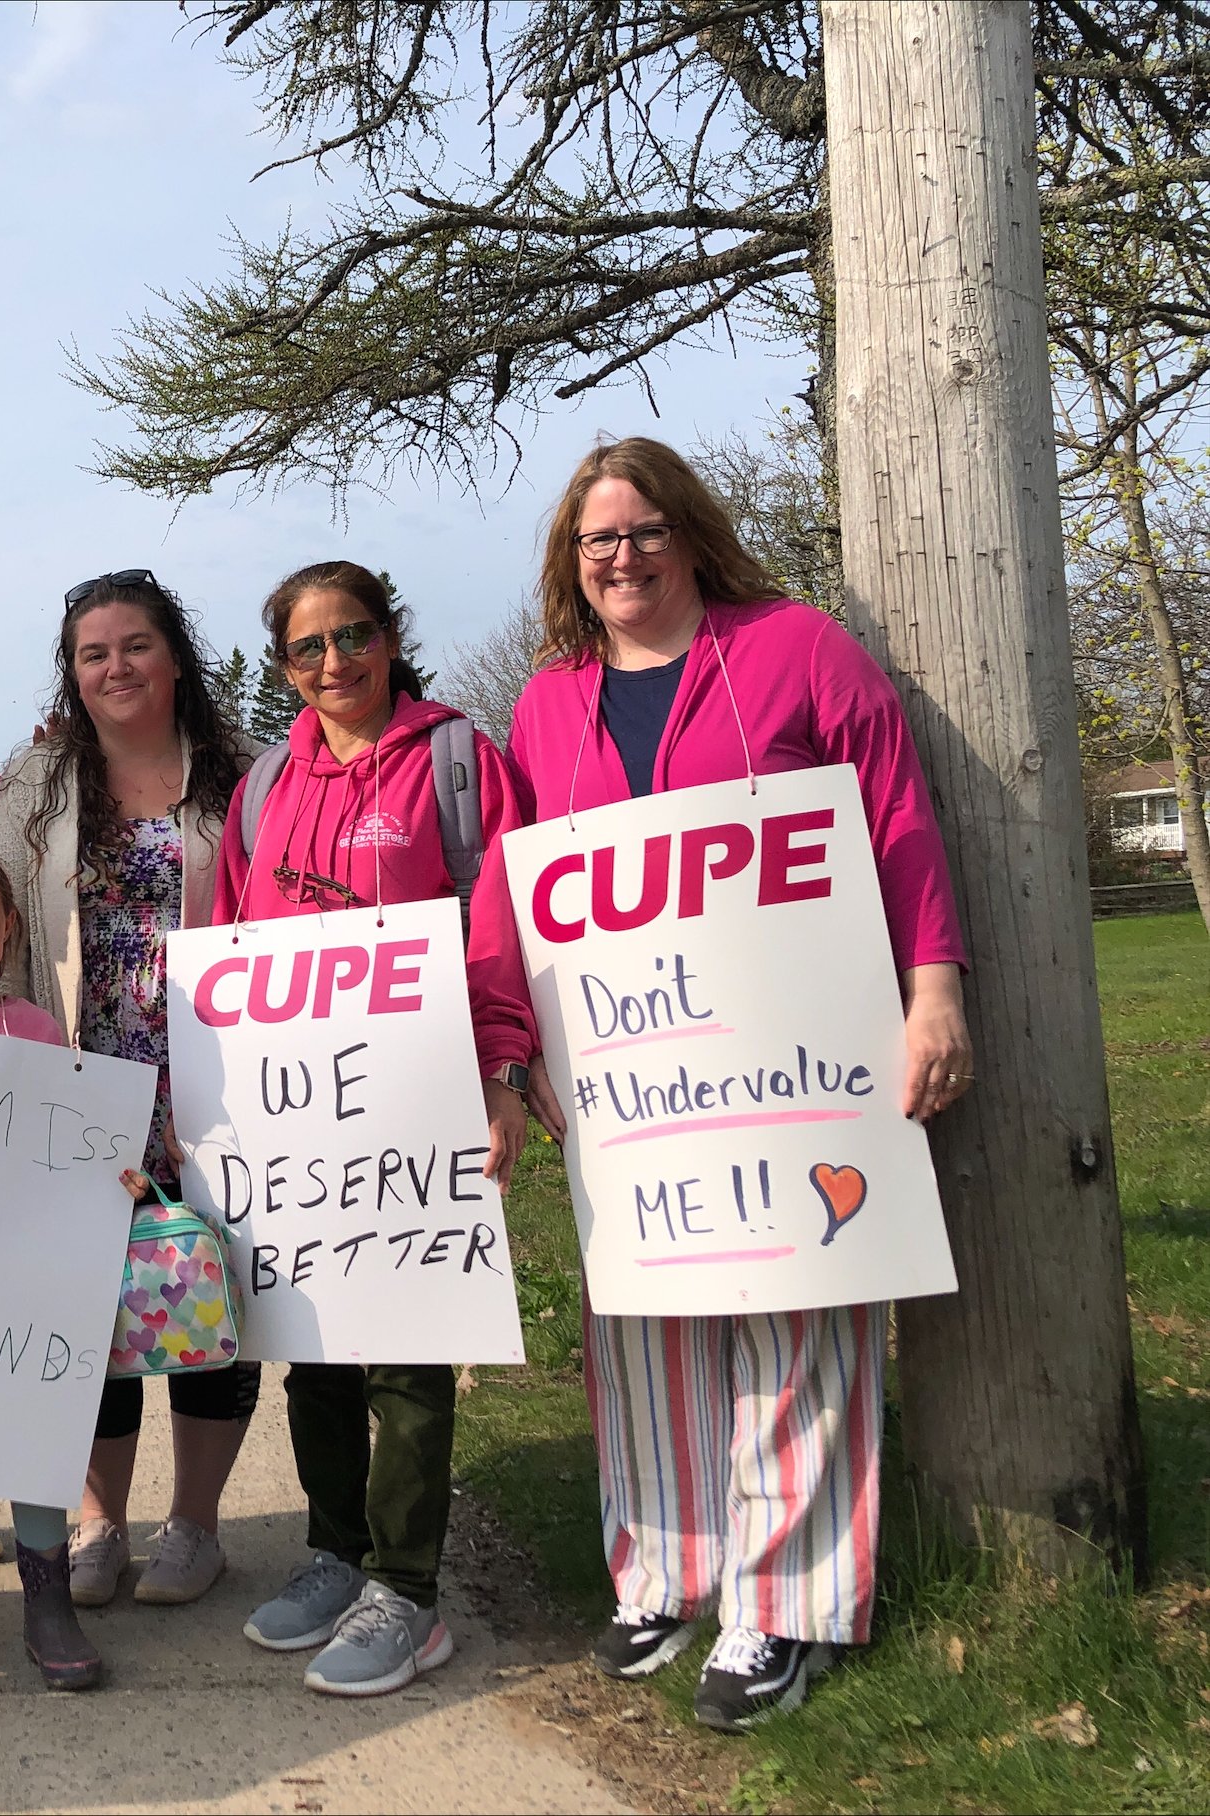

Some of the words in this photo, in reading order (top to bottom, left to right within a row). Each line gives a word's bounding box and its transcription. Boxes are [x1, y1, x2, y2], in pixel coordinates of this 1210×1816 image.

[379, 833, 410, 847] STORE
[531, 807, 835, 944] CUPE
[193, 938, 430, 1028] CUPE
[579, 954, 713, 1039] Don't
[261, 1042, 368, 1121] WE
[574, 1044, 874, 1122] #Undervalue
[220, 1143, 491, 1225] DESERVE
[252, 1223, 505, 1295] BETTER
